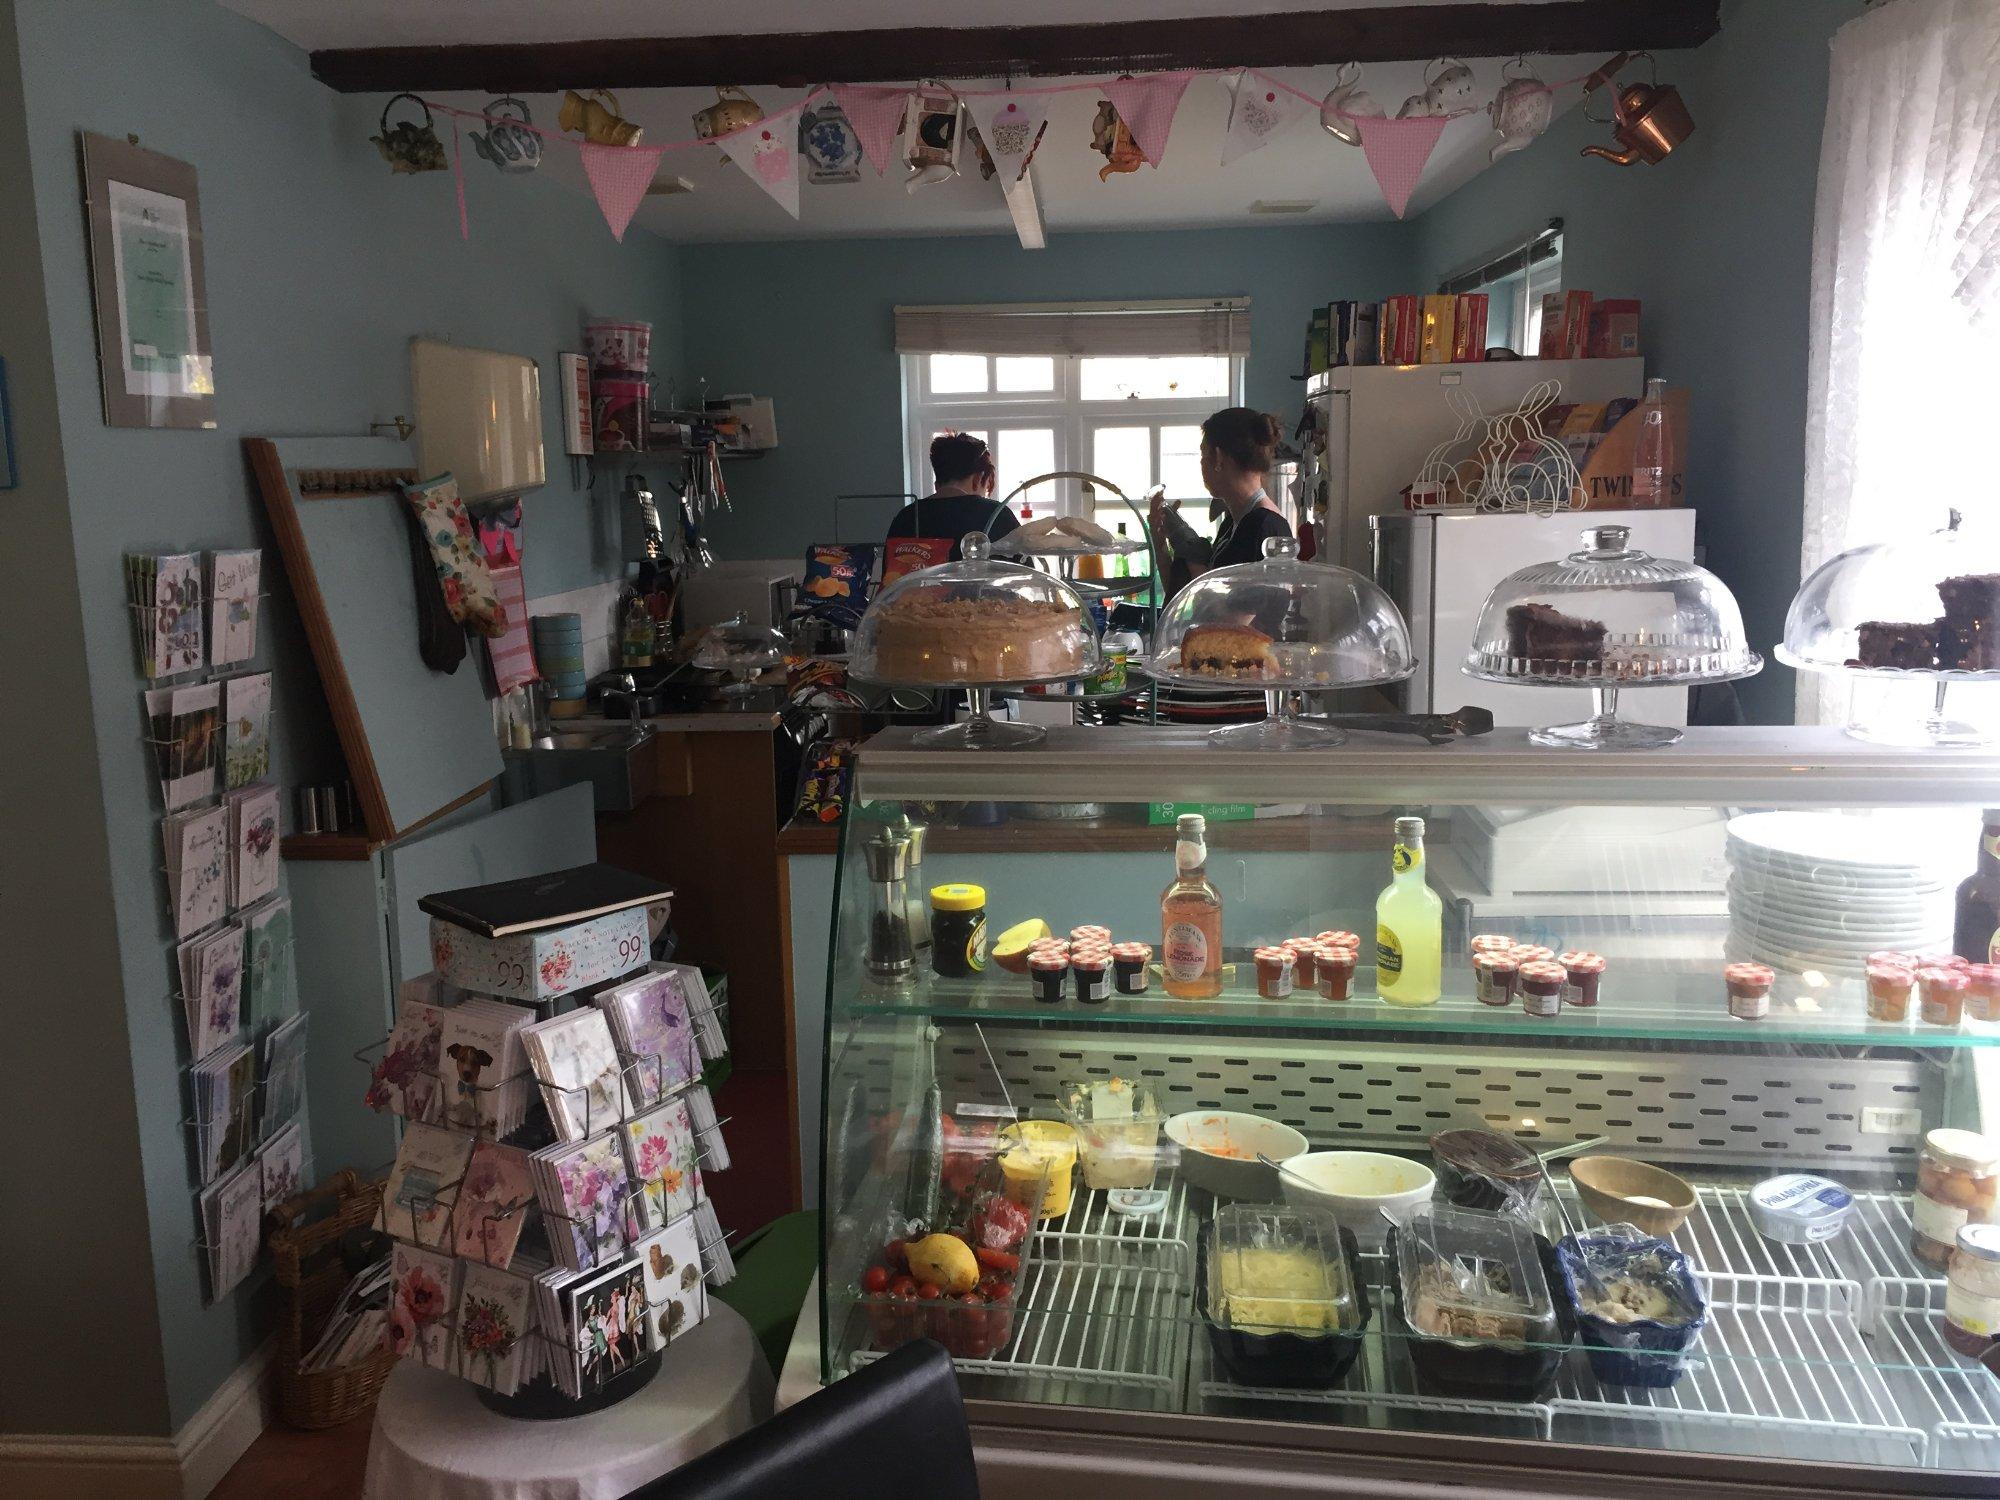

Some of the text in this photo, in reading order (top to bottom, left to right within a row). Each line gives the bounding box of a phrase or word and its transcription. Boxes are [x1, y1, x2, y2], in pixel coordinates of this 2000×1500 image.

[895, 544, 931, 560] WALKERS
[1162, 802, 1174, 818] 30
[1207, 803, 1246, 816] cling film
[1167, 953, 1205, 963] LEMONADE
[1759, 1179, 1823, 1206] PHILADELPHIA
